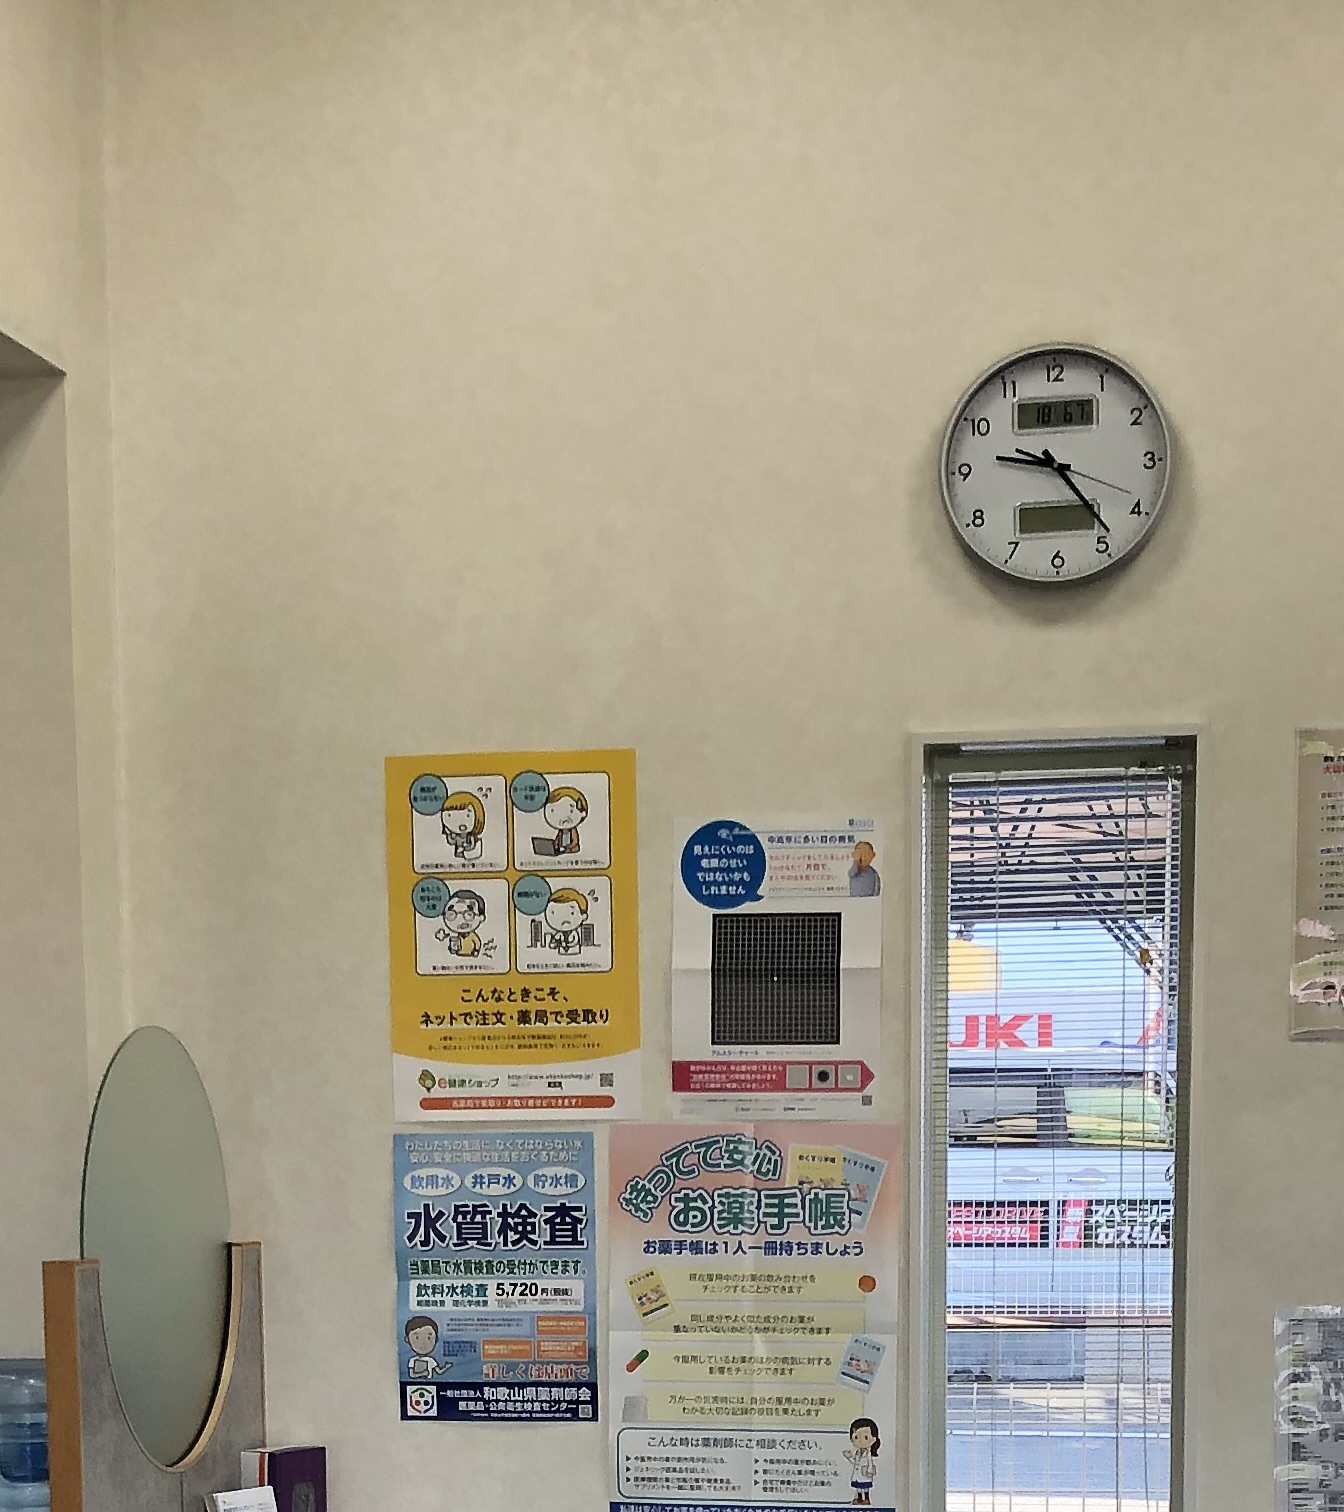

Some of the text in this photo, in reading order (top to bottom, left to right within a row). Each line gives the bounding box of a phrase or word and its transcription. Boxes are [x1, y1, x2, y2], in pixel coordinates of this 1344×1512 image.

[1046, 365, 1065, 383] 12
[1001, 375, 1017, 398] 11
[1129, 407, 1143, 426] 2
[970, 418, 991, 437] 10
[1143, 451, 1156, 470] 3
[958, 463, 972, 482] 9
[1129, 499, 1142, 516] 4
[971, 509, 985, 528] 8
[1007, 542, 1020, 560] 7
[1095, 536, 1110, 554] 5
[1050, 550, 1065, 569] 6
[460, 986, 570, 1003] こんなときこそ、
[420, 1009, 610, 1027] ネットで注文・薬局で受取り
[471, 1173, 517, 1190] 井戸水
[669, 1187, 853, 1235] お薬手帳
[405, 1202, 587, 1250] 水質検査
[409, 1259, 587, 1276] 当薬局で水質検査の受付ができます。
[416, 1283, 488, 1298] 飲料水検査
